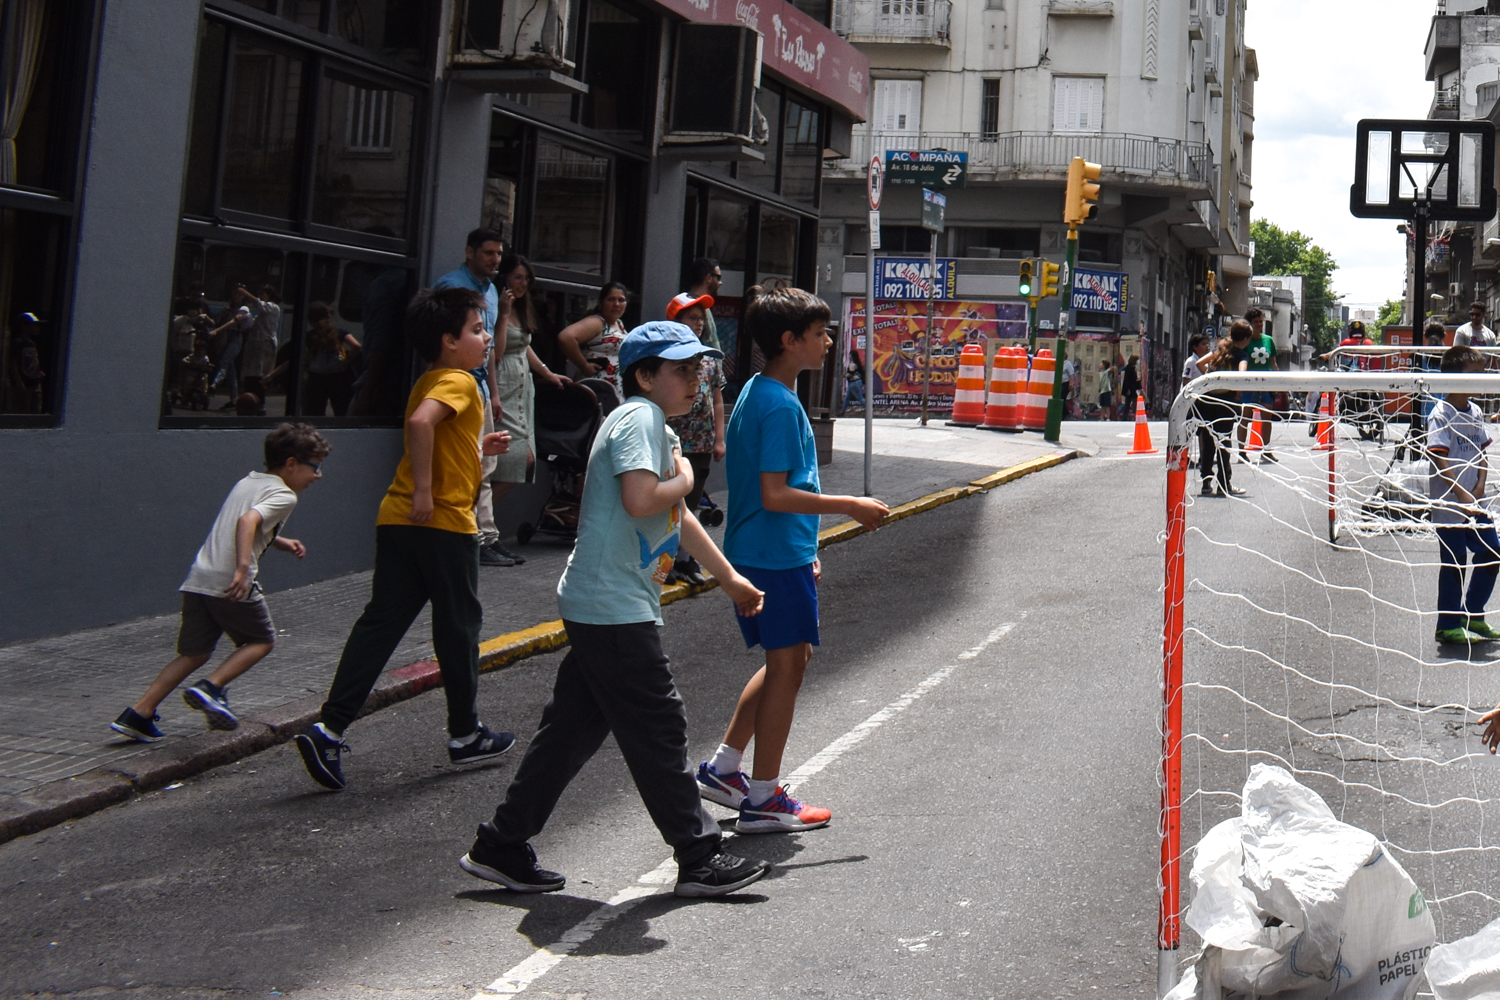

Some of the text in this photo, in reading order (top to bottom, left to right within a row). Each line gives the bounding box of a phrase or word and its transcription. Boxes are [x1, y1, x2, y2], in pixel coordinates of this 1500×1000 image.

[884, 283, 903, 298] 092
[905, 284, 921, 298] 110
[901, 267, 931, 292] ALQUILAD
[947, 261, 956, 298] ALQUILA
[1073, 293, 1088, 309] 092
[1089, 295, 1102, 310] 110
[1391, 355, 1413, 365] Pea
[1377, 945, 1432, 973] PLÁSTIC
[1379, 963, 1418, 986] PAPEL
